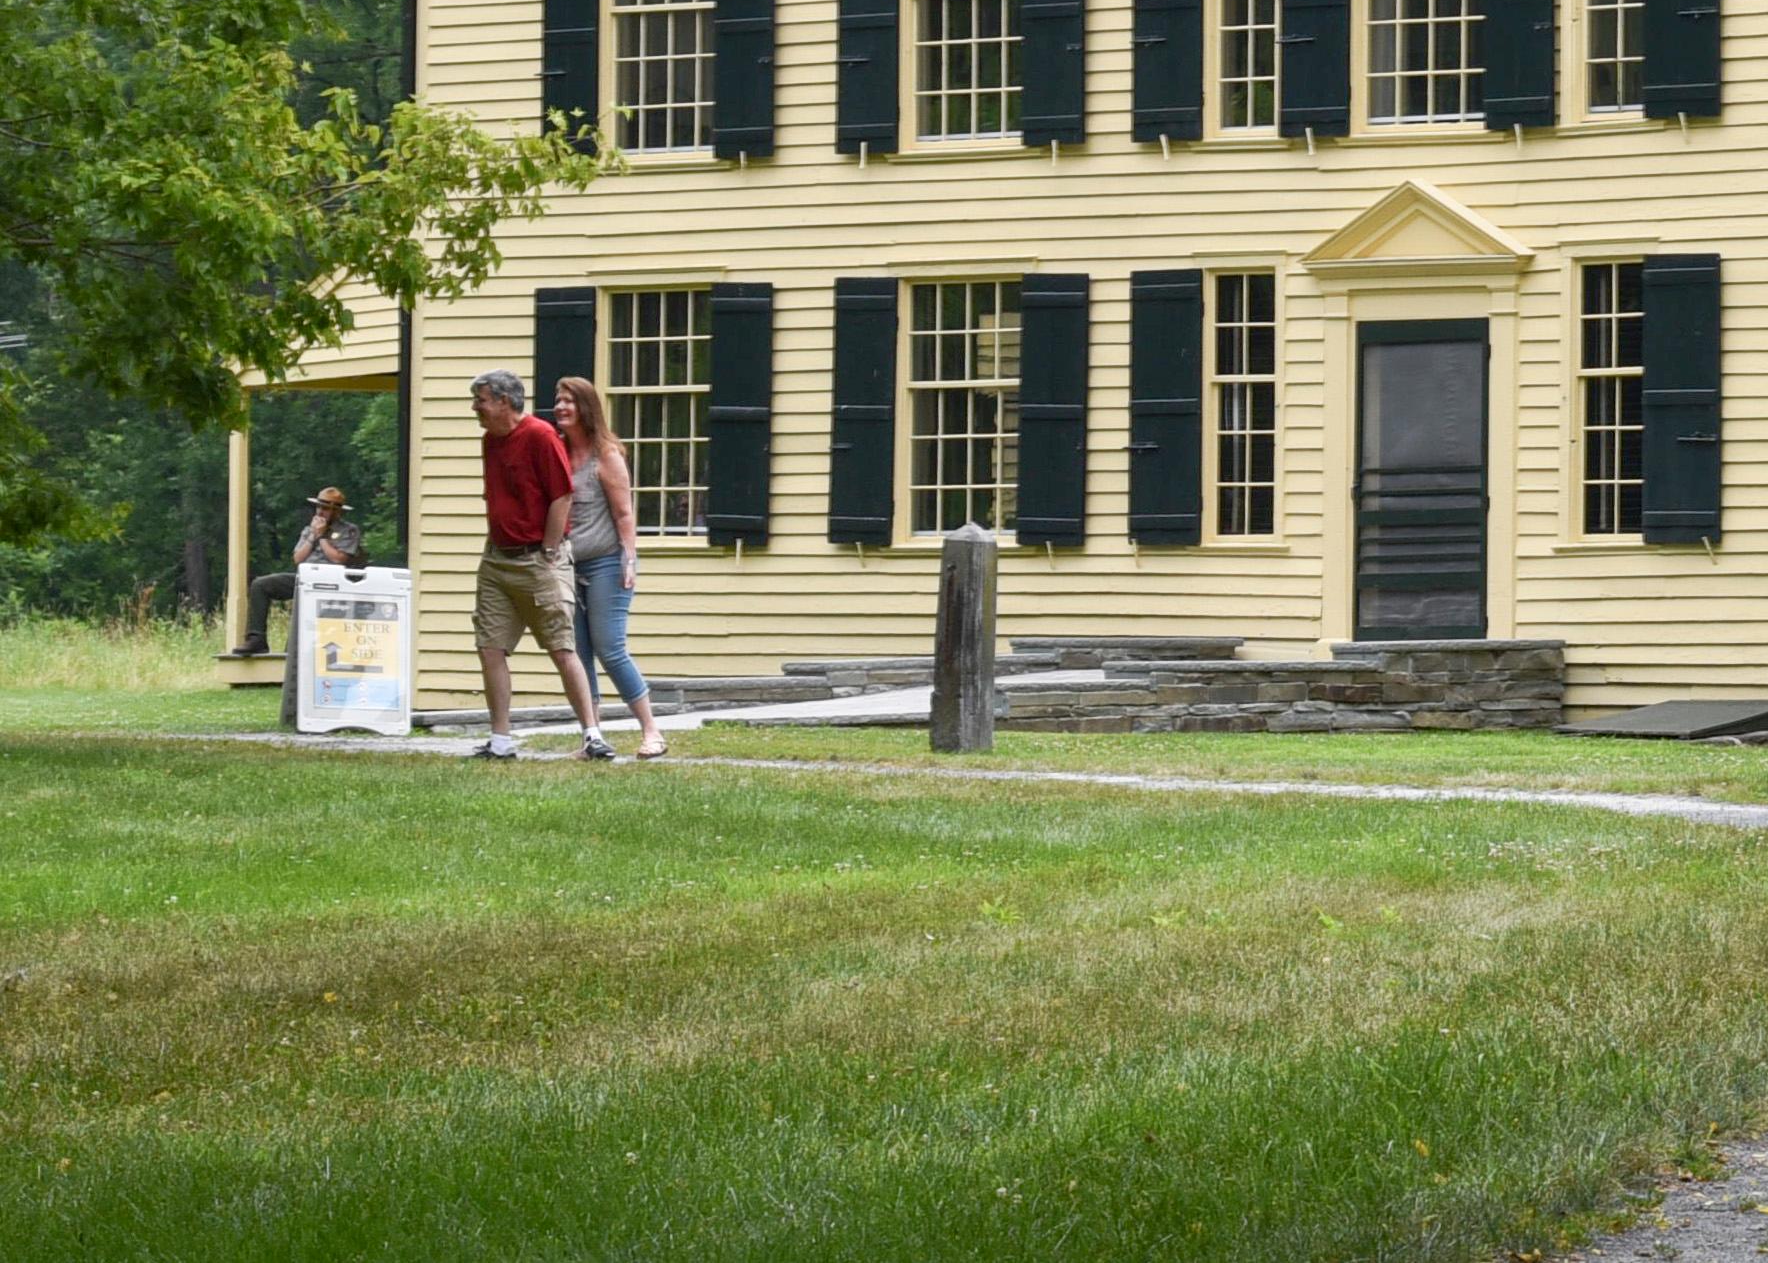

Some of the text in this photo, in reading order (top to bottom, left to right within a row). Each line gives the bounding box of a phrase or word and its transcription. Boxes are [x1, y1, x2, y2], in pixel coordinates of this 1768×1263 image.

[344, 623, 391, 634] ENTER
[356, 635, 377, 645] ON
[351, 648, 384, 659] SIDE
